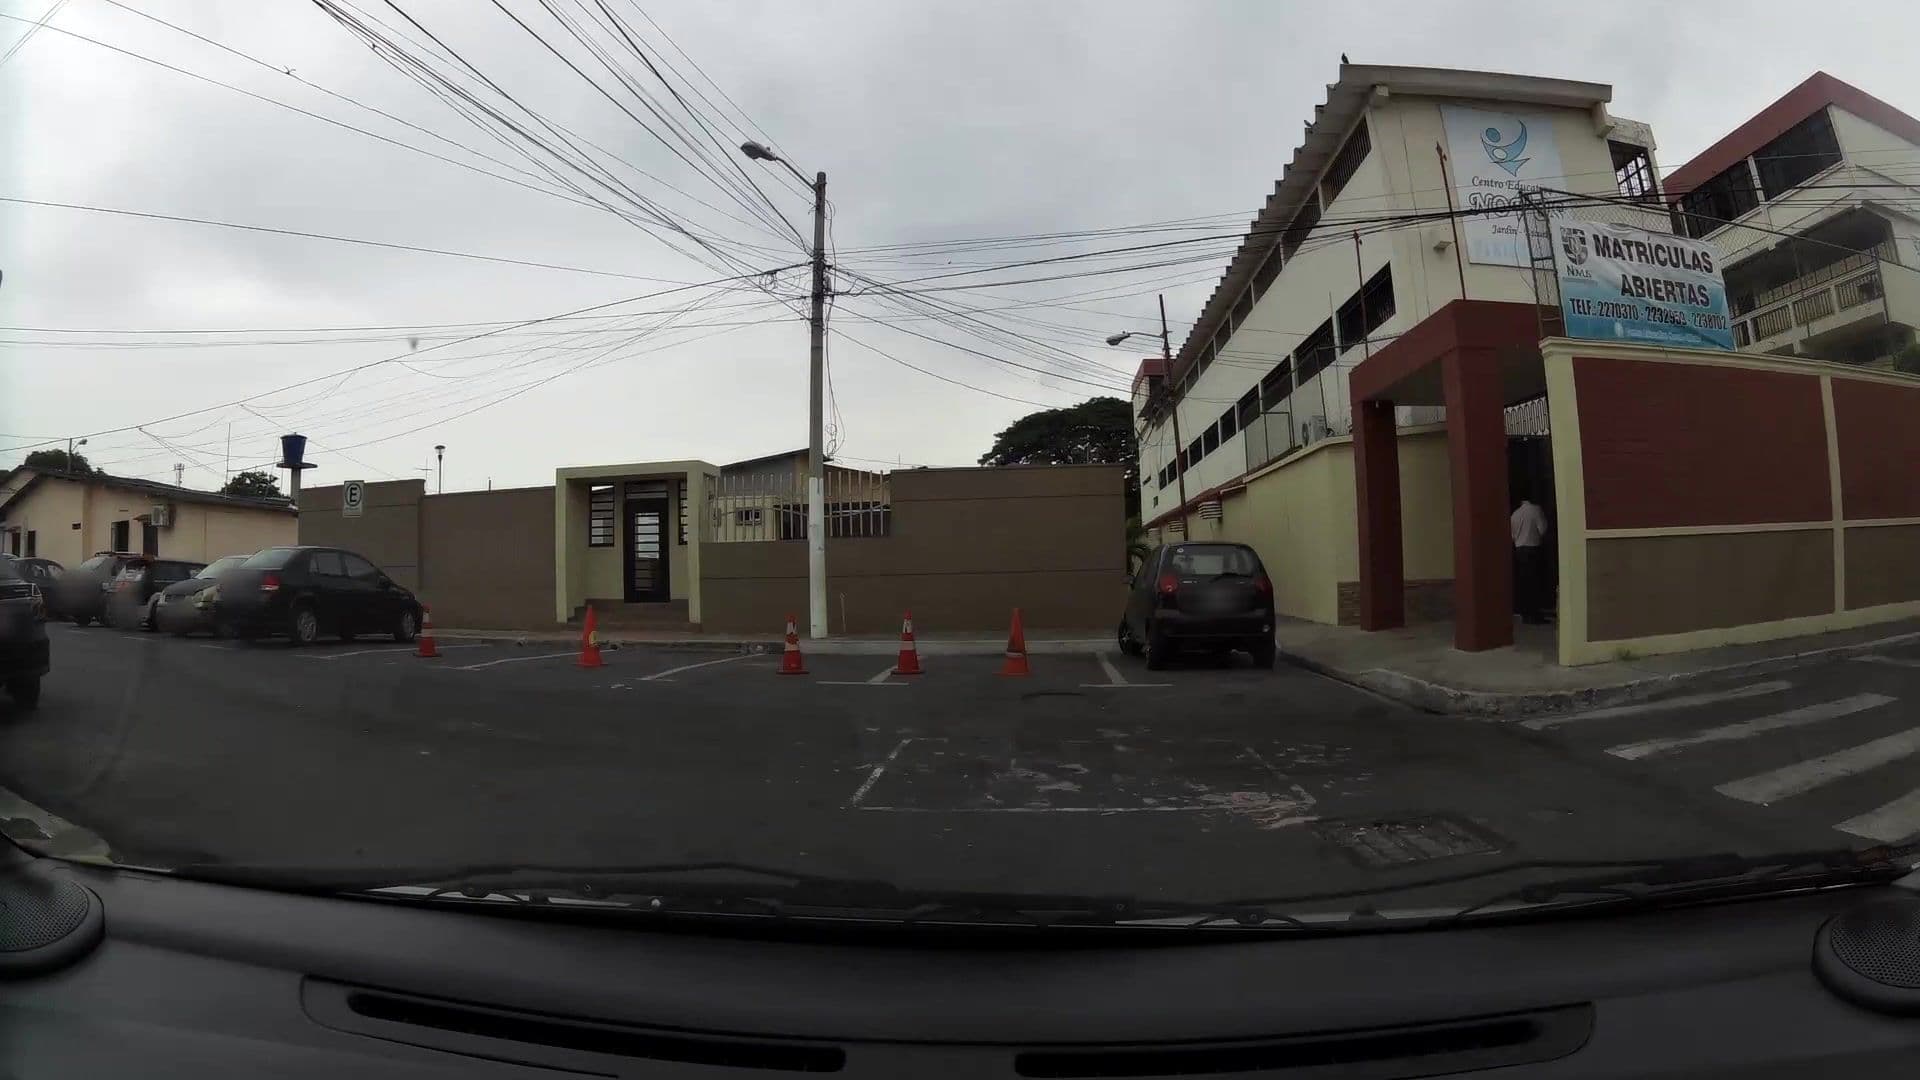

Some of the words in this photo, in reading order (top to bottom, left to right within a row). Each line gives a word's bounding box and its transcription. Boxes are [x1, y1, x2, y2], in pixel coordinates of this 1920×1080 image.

[1472, 175, 1504, 189] Centro
[1620, 273, 1711, 307] ABIERTAS
[349, 486, 358, 503] E
